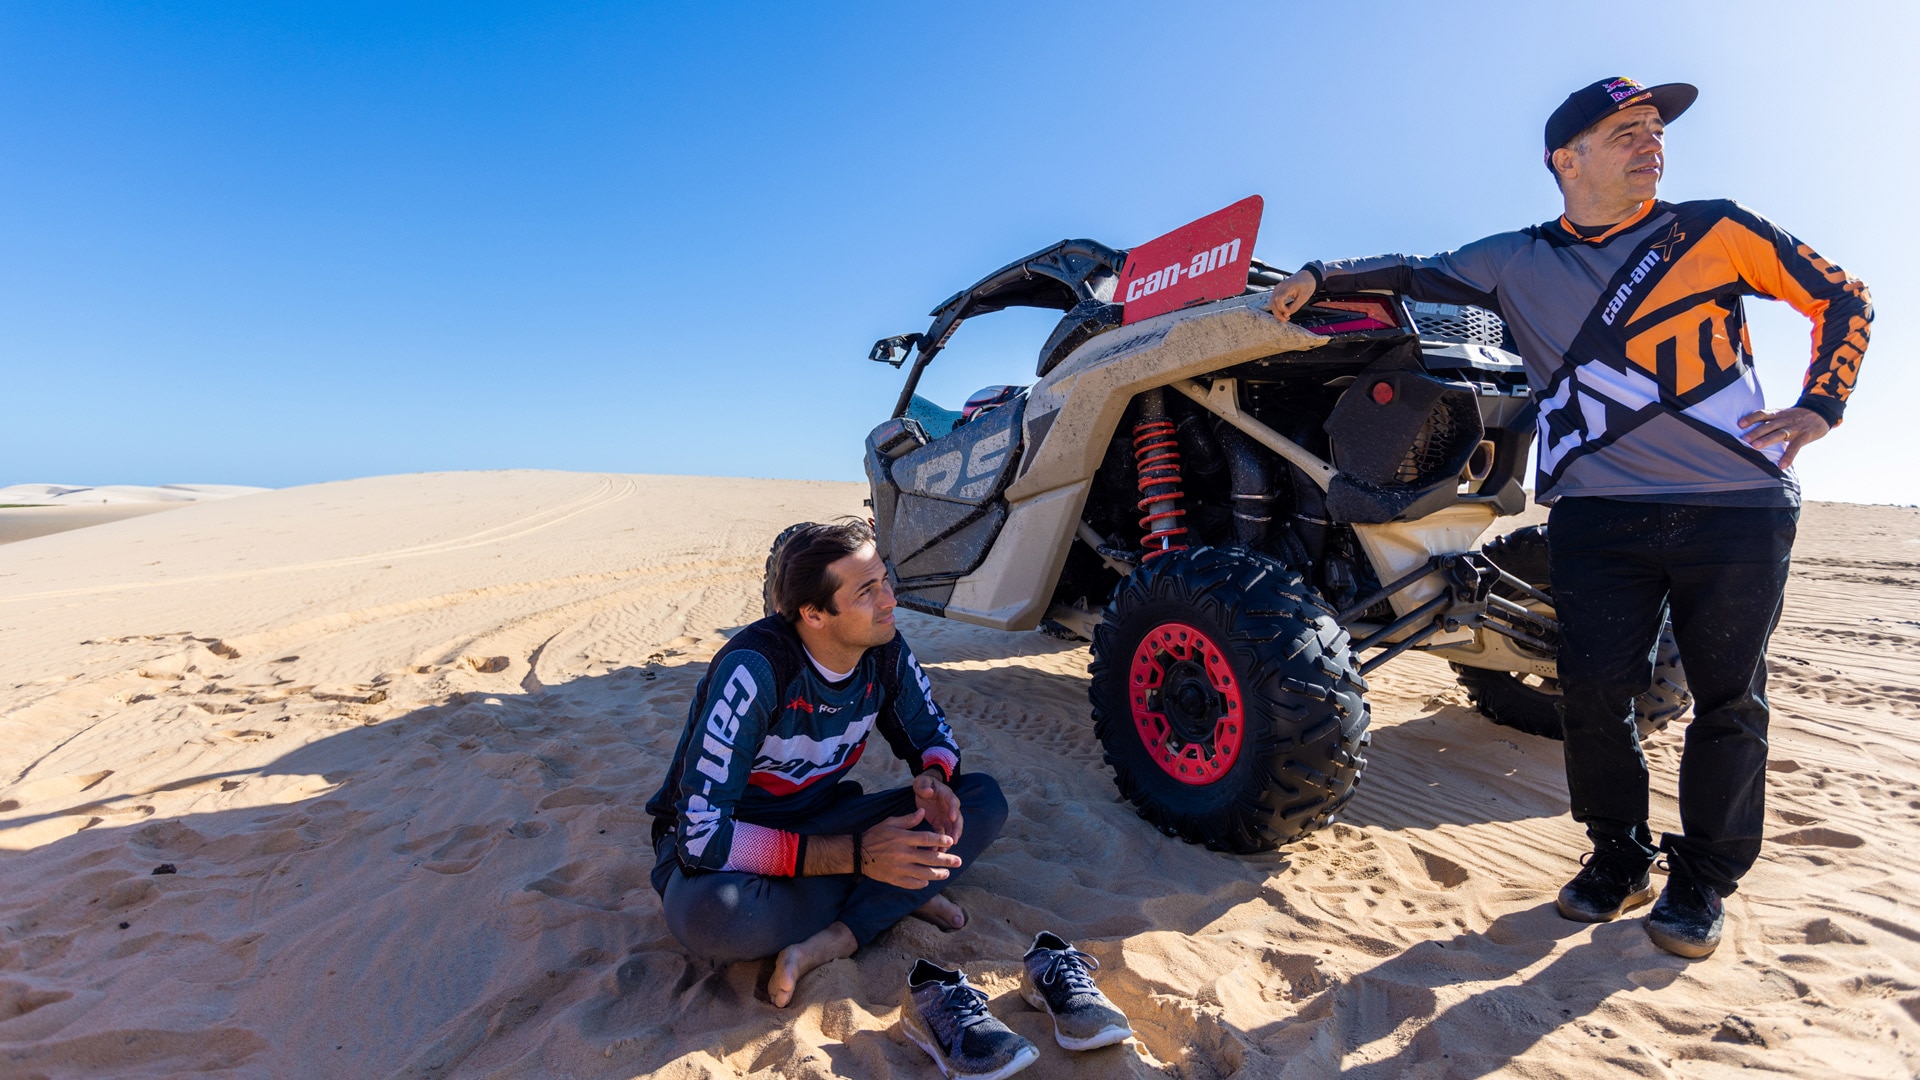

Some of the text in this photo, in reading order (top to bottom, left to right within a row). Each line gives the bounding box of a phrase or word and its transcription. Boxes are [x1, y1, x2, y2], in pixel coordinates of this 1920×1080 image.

[1610, 87, 1638, 102] Red
[1126, 238, 1241, 303] can-am
[1602, 250, 1660, 326] can-am
[685, 664, 758, 858] can-am
